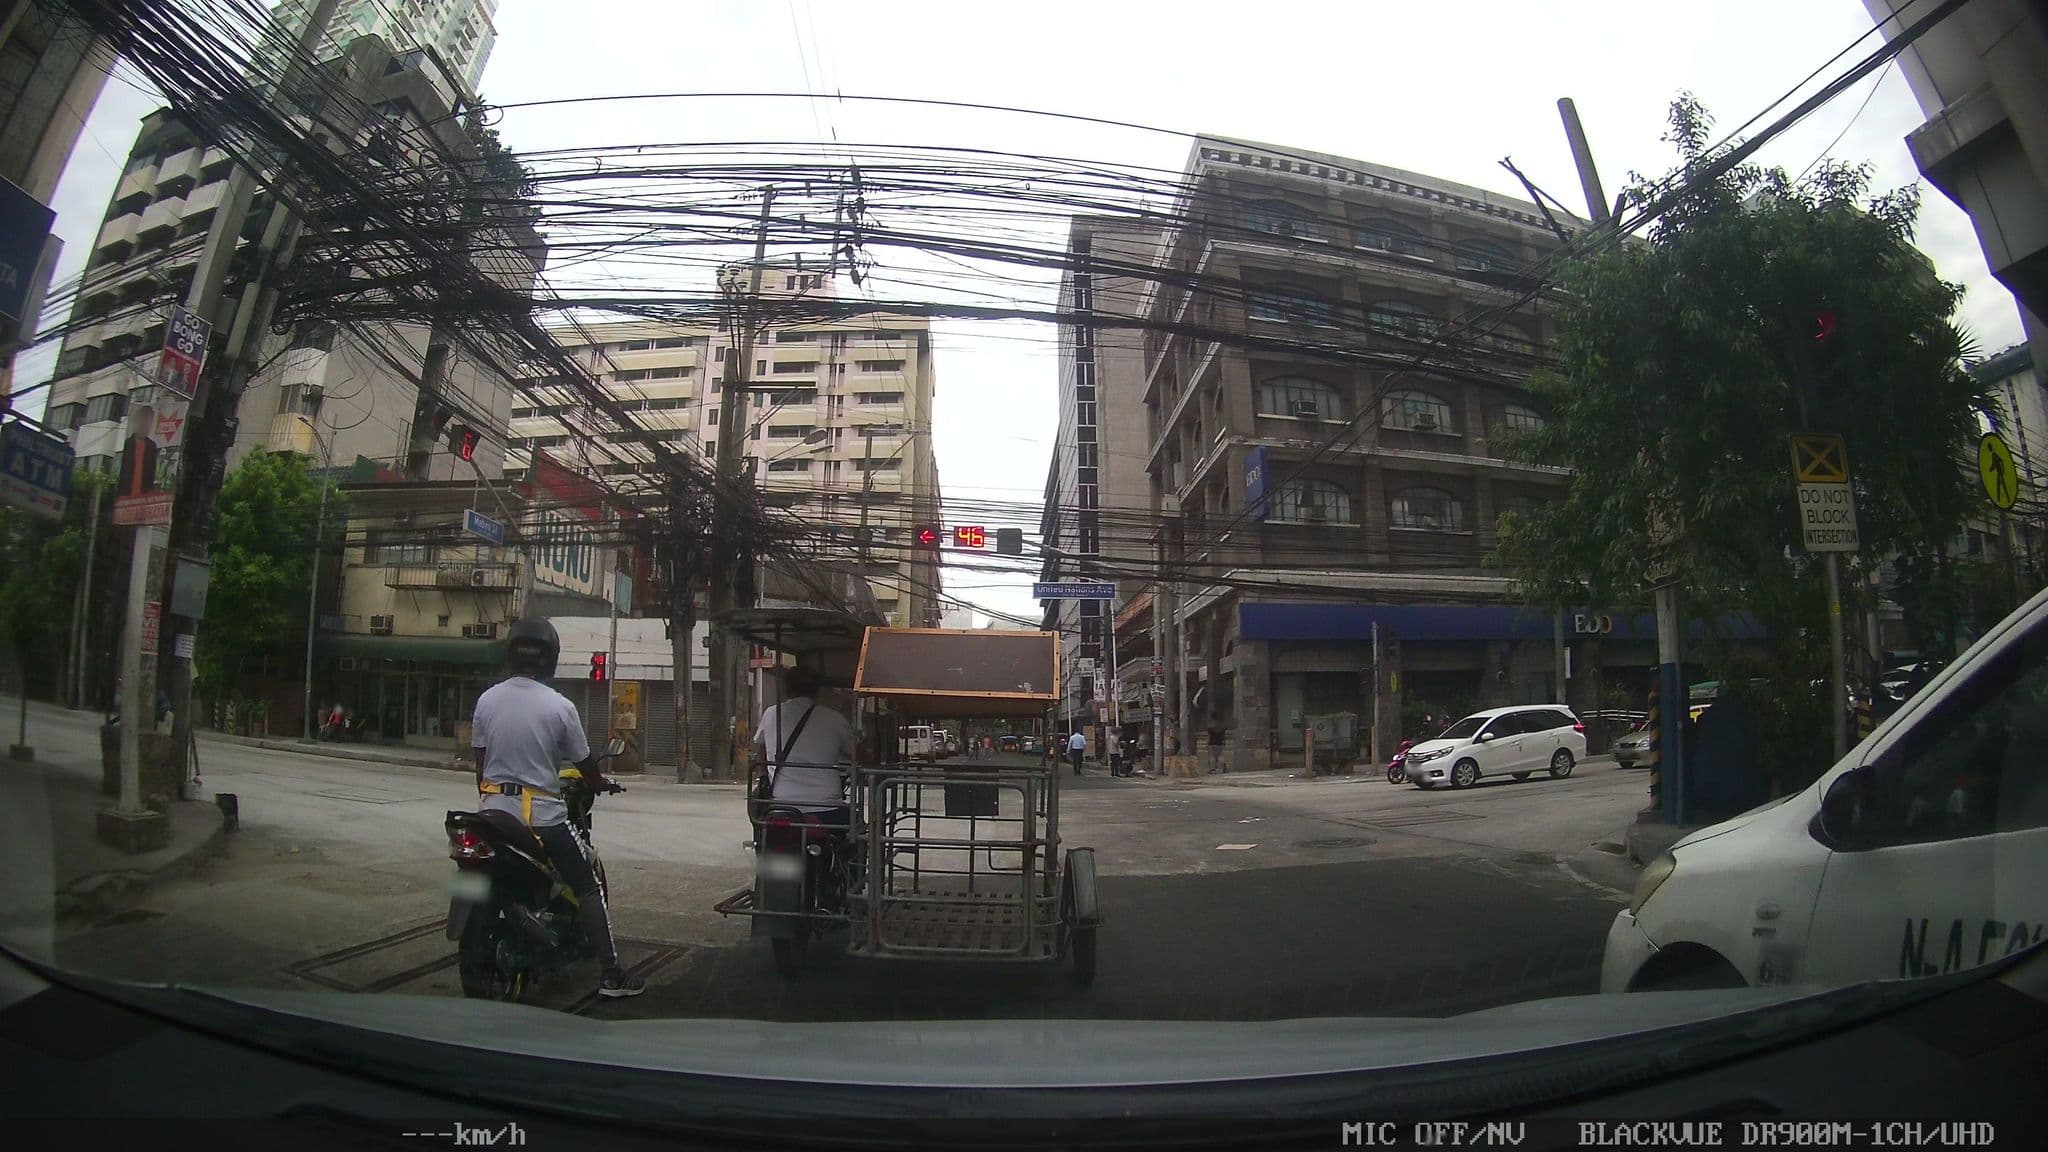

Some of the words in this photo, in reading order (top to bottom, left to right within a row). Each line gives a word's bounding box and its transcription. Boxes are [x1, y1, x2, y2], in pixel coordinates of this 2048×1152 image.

[184, 313, 200, 330] GO
[173, 321, 203, 345] BONG
[177, 338, 194, 354] GO
[8, 452, 64, 493] ATM
[1246, 465, 1260, 487] BDO
[1801, 489, 1821, 504] DO
[1823, 490, 1849, 504] NOT
[1807, 509, 1849, 524] BLOCK
[958, 527, 983, 547] 46
[1804, 529, 1857, 545] INTERSECTION
[1037, 584, 1064, 593] United
[1064, 584, 1095, 594] Nations
[1096, 585, 1113, 594] Ave
[1574, 613, 1612, 634] BDO
